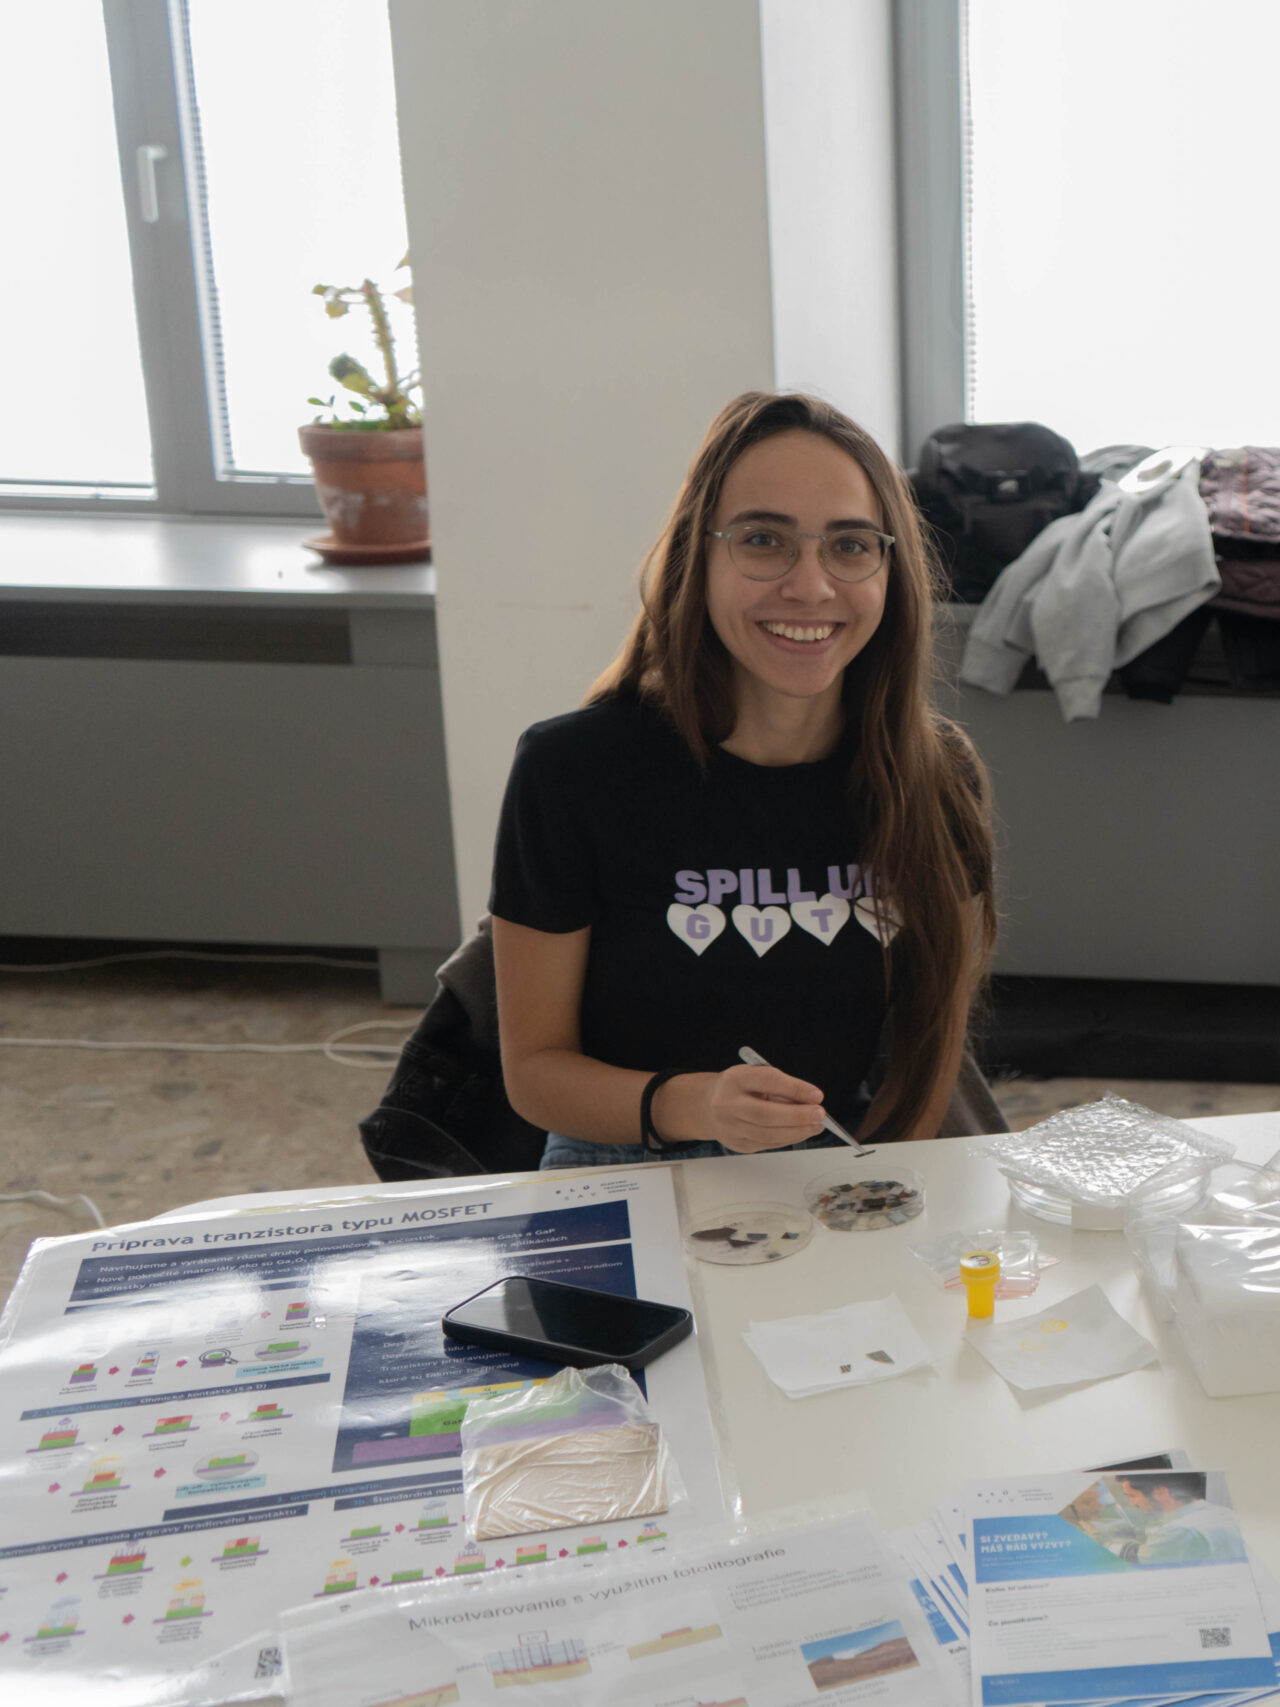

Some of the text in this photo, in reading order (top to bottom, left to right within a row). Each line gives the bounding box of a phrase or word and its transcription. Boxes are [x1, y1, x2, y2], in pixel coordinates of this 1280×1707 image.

[674, 868, 818, 905] SPILL
[203, 1223, 333, 1243] tranzistora
[341, 1216, 393, 1231] typu
[401, 1203, 493, 1223] MOSFET
[408, 1596, 567, 1632] Mikrotvarovanie
[588, 1571, 669, 1602] využitím
[673, 1546, 787, 1582] fotolitografie
